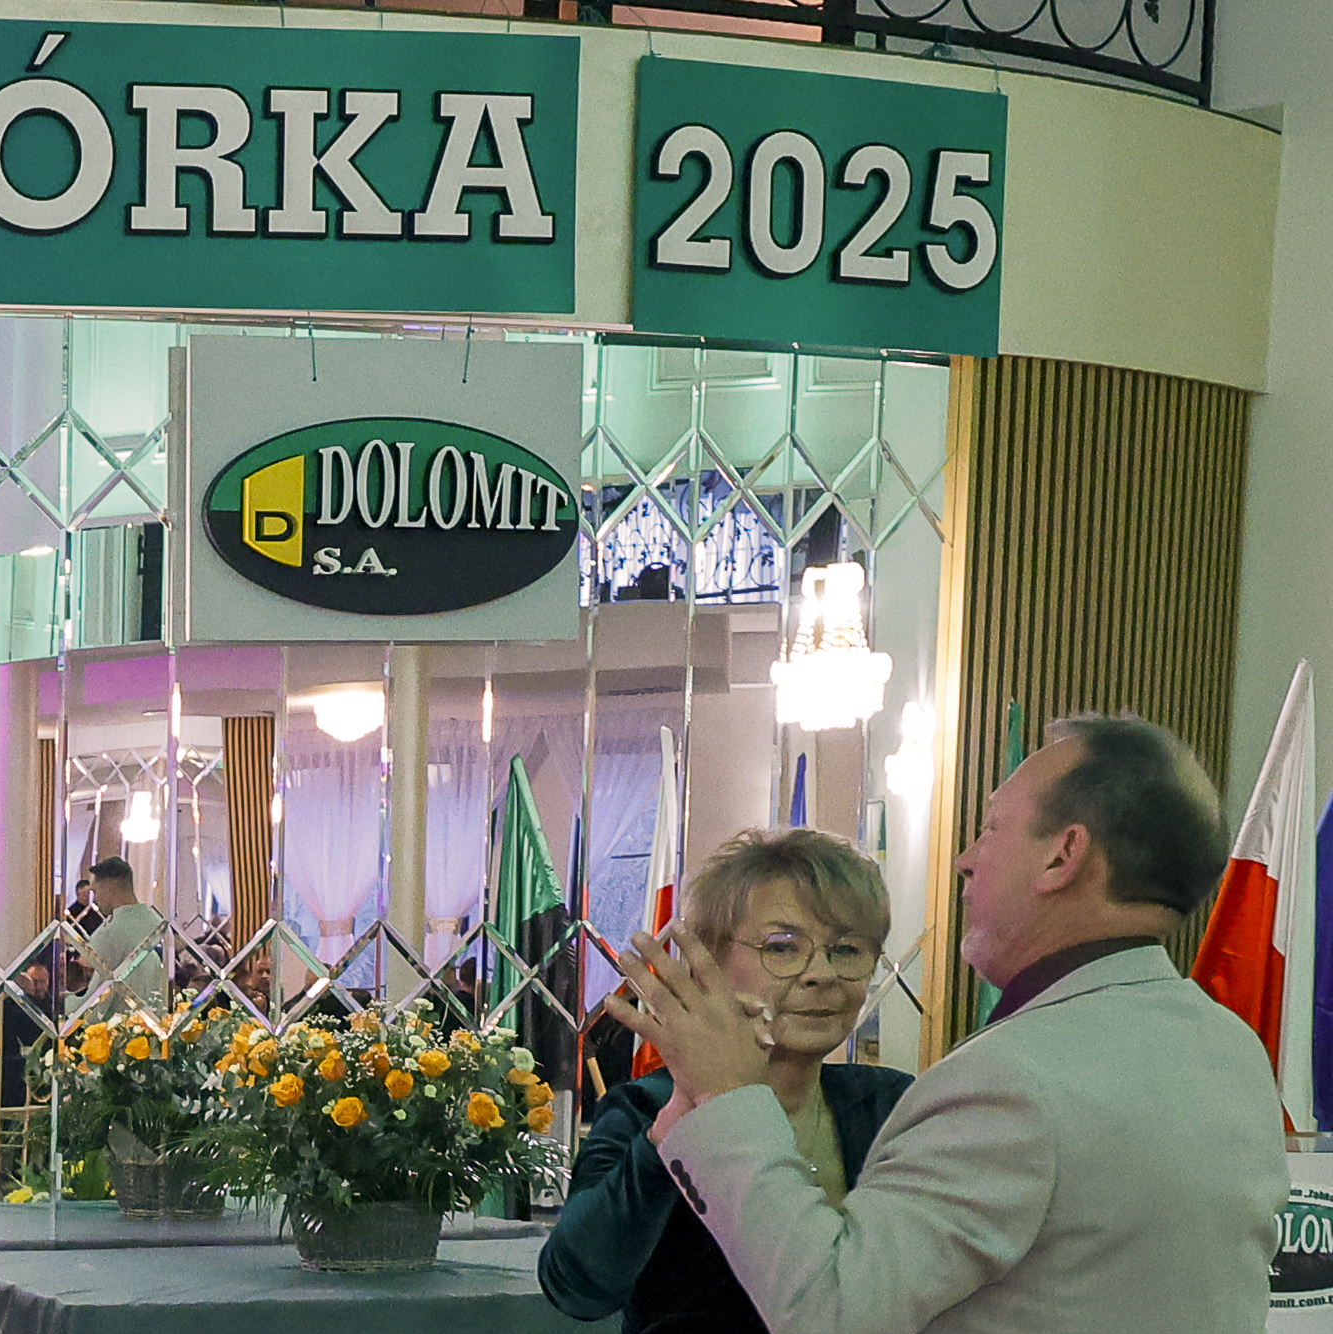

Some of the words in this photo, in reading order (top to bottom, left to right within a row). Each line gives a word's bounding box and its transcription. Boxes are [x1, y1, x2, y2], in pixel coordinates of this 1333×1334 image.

[649, 123, 999, 293] 2025
[316, 439, 568, 531] DOLOMIT
[312, 547, 398, 576] S.A.
